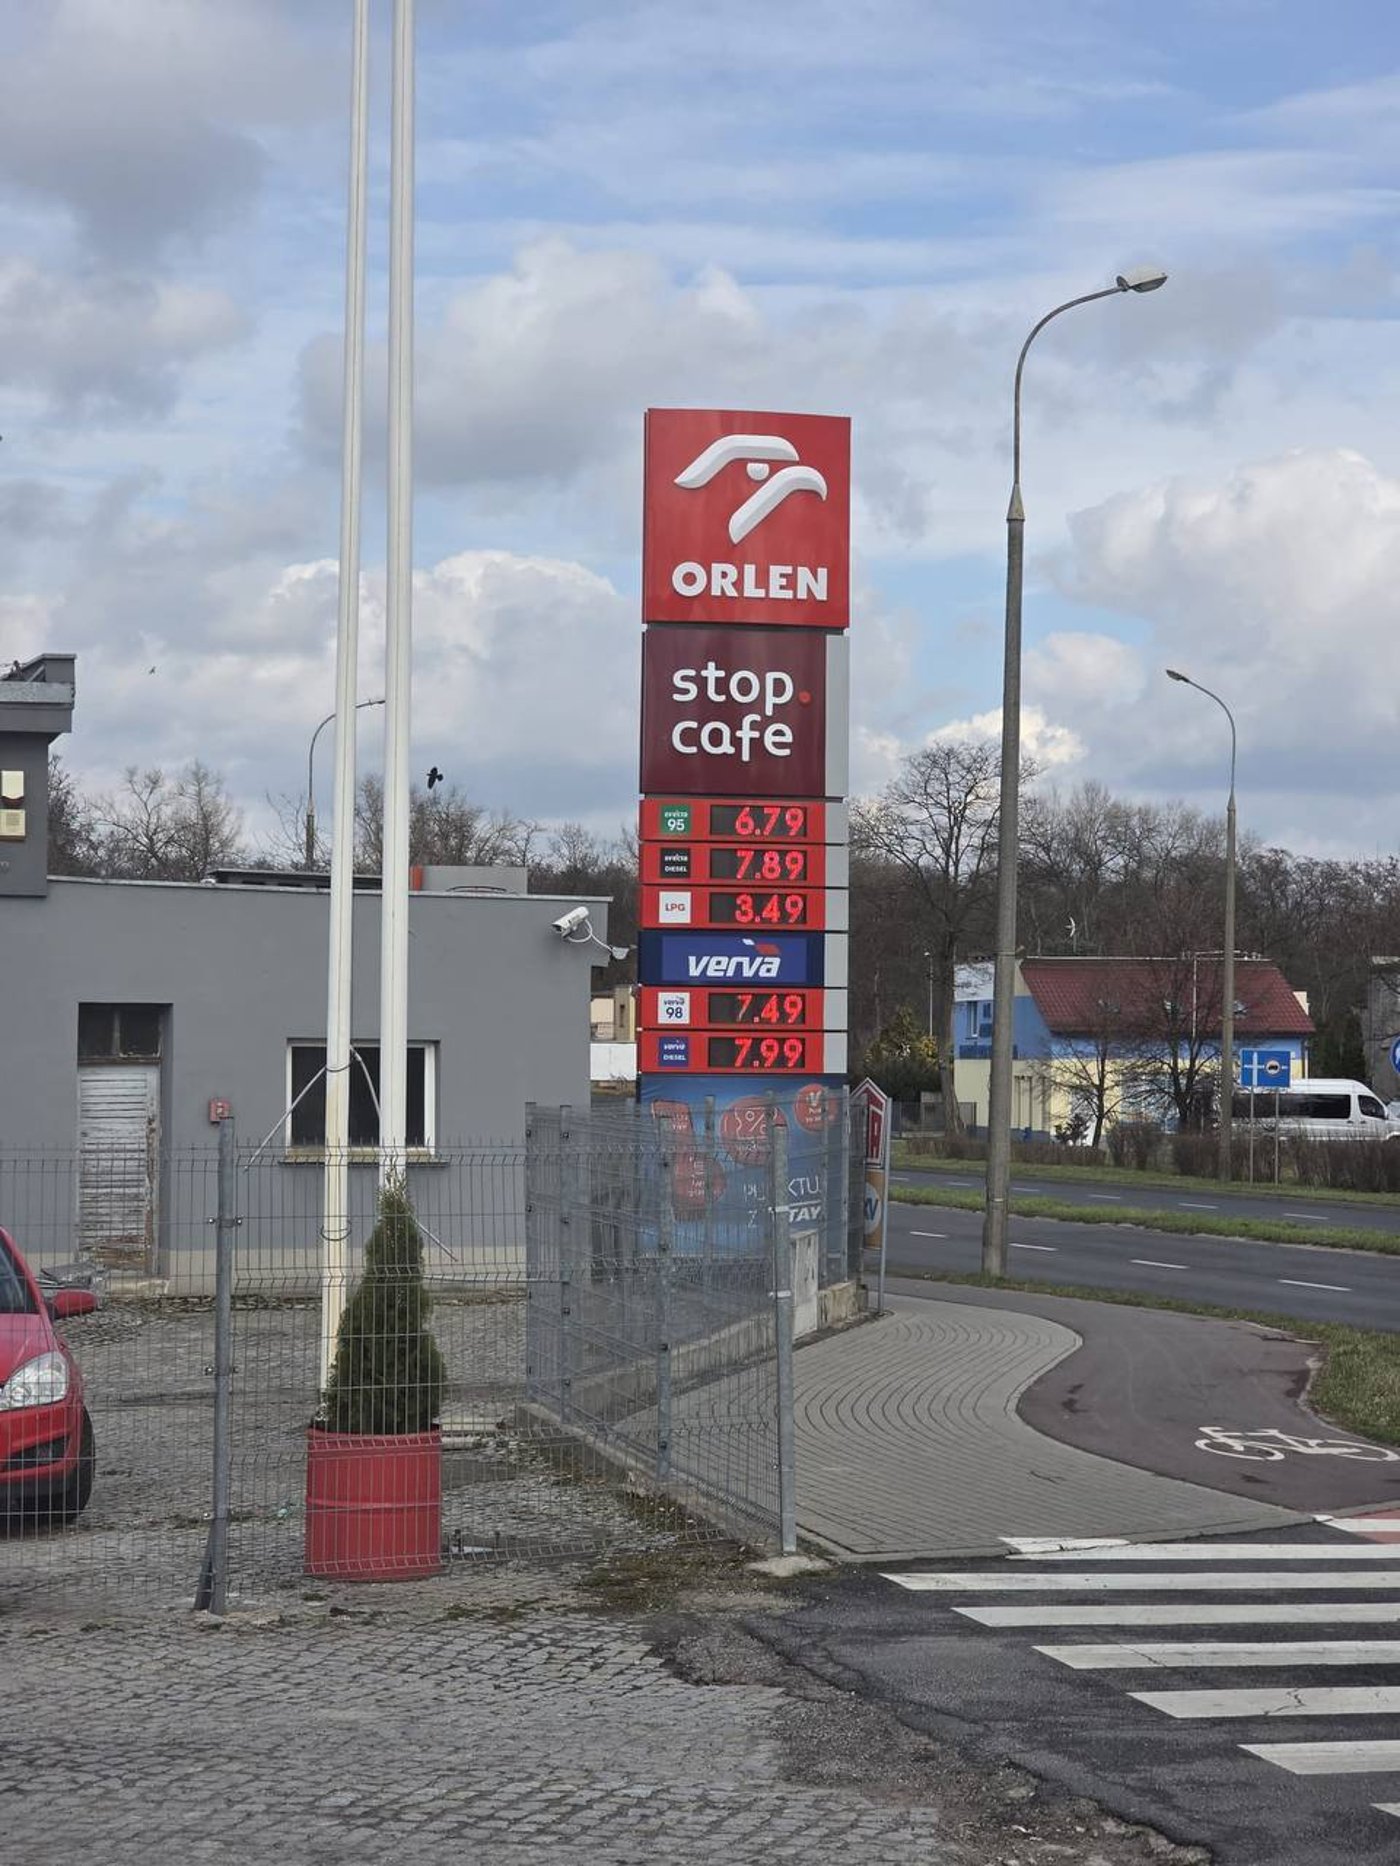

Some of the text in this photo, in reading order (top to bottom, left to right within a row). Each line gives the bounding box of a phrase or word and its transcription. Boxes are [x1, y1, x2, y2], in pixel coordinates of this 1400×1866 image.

[672, 561, 828, 601] ORLEN
[672, 713, 793, 762] cafe
[667, 818, 685, 831] 95
[735, 806, 805, 836] 6.79
[664, 865, 688, 873] DIESEL
[736, 850, 805, 880] 7.89
[665, 903, 686, 912] LPG
[735, 894, 805, 923] 3.49
[688, 955, 781, 978] verva
[665, 1006, 683, 1019] 98
[736, 994, 803, 1024] 7.49
[734, 1037, 803, 1067] 7.99
